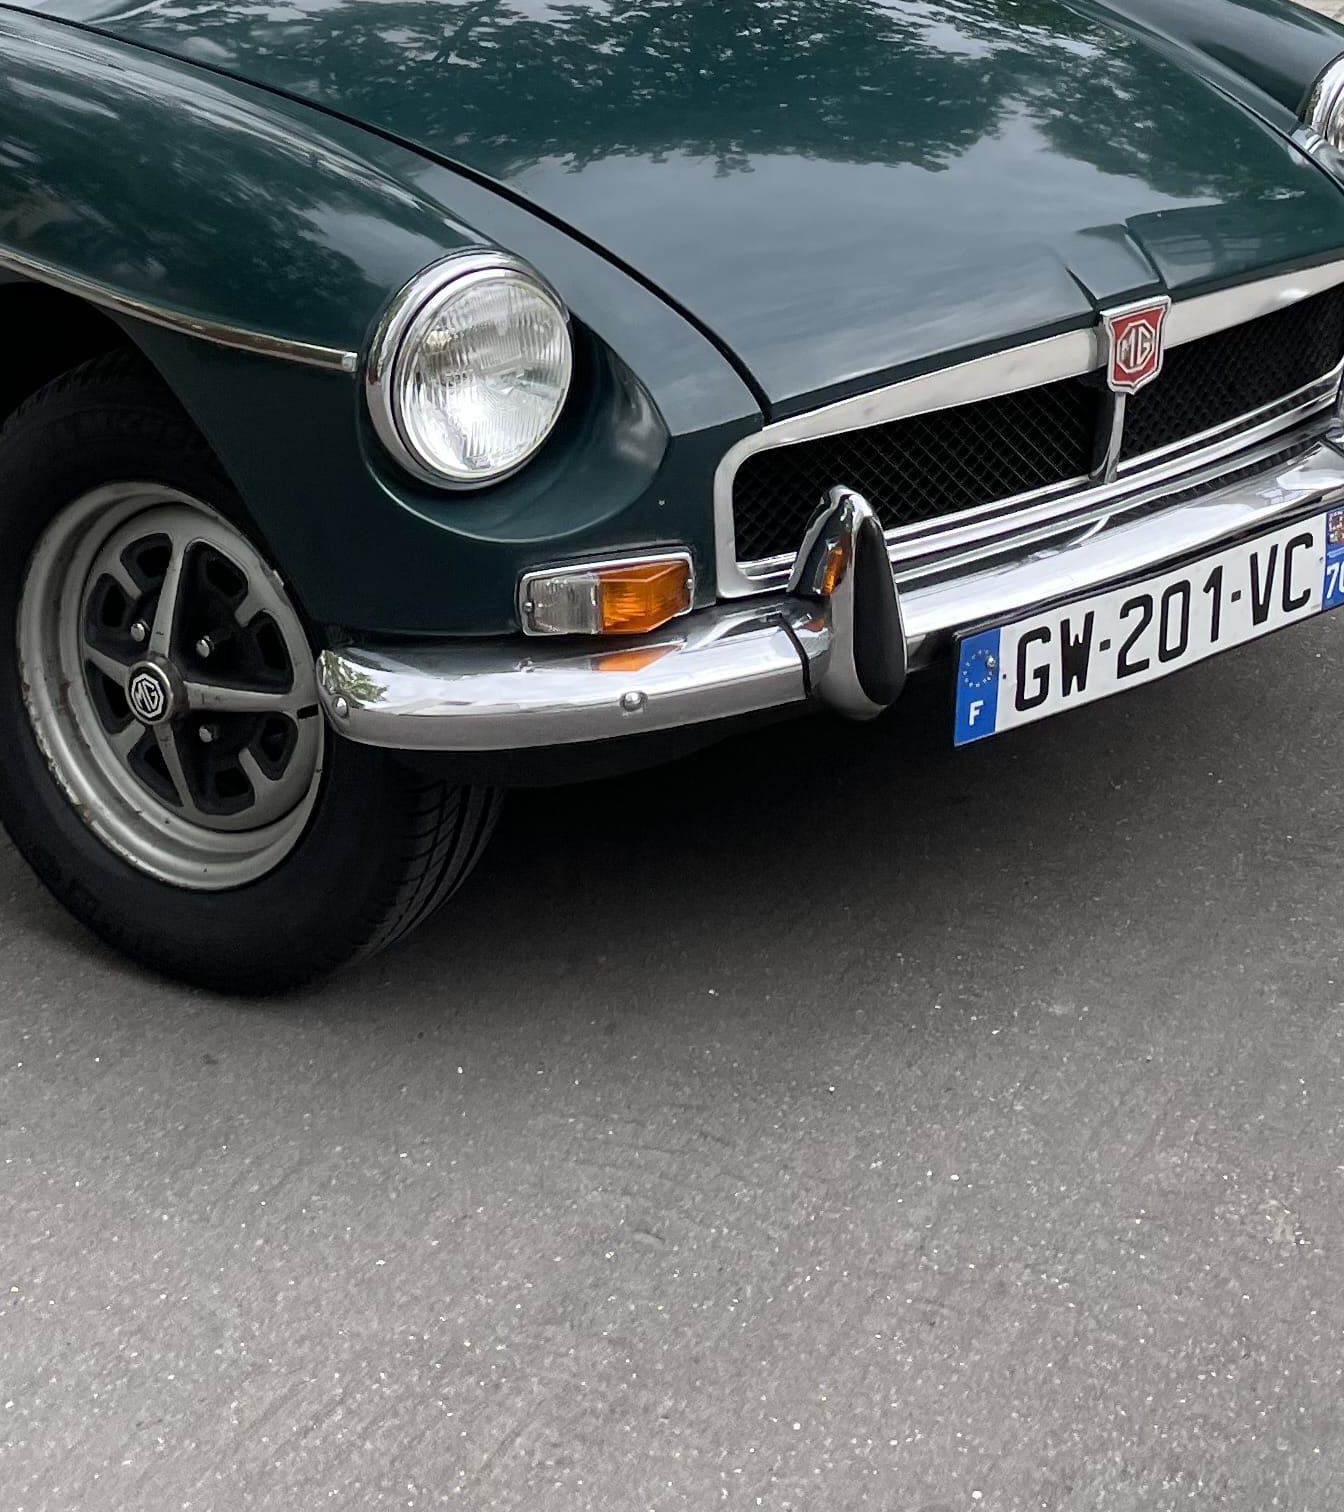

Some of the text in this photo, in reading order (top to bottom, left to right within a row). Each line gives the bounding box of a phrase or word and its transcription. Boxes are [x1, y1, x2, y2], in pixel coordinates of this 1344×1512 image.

[1121, 326, 1152, 368] MG
[1015, 532, 1314, 711] GW-201-VC
[135, 680, 159, 712] MG
[968, 700, 984, 726] F
